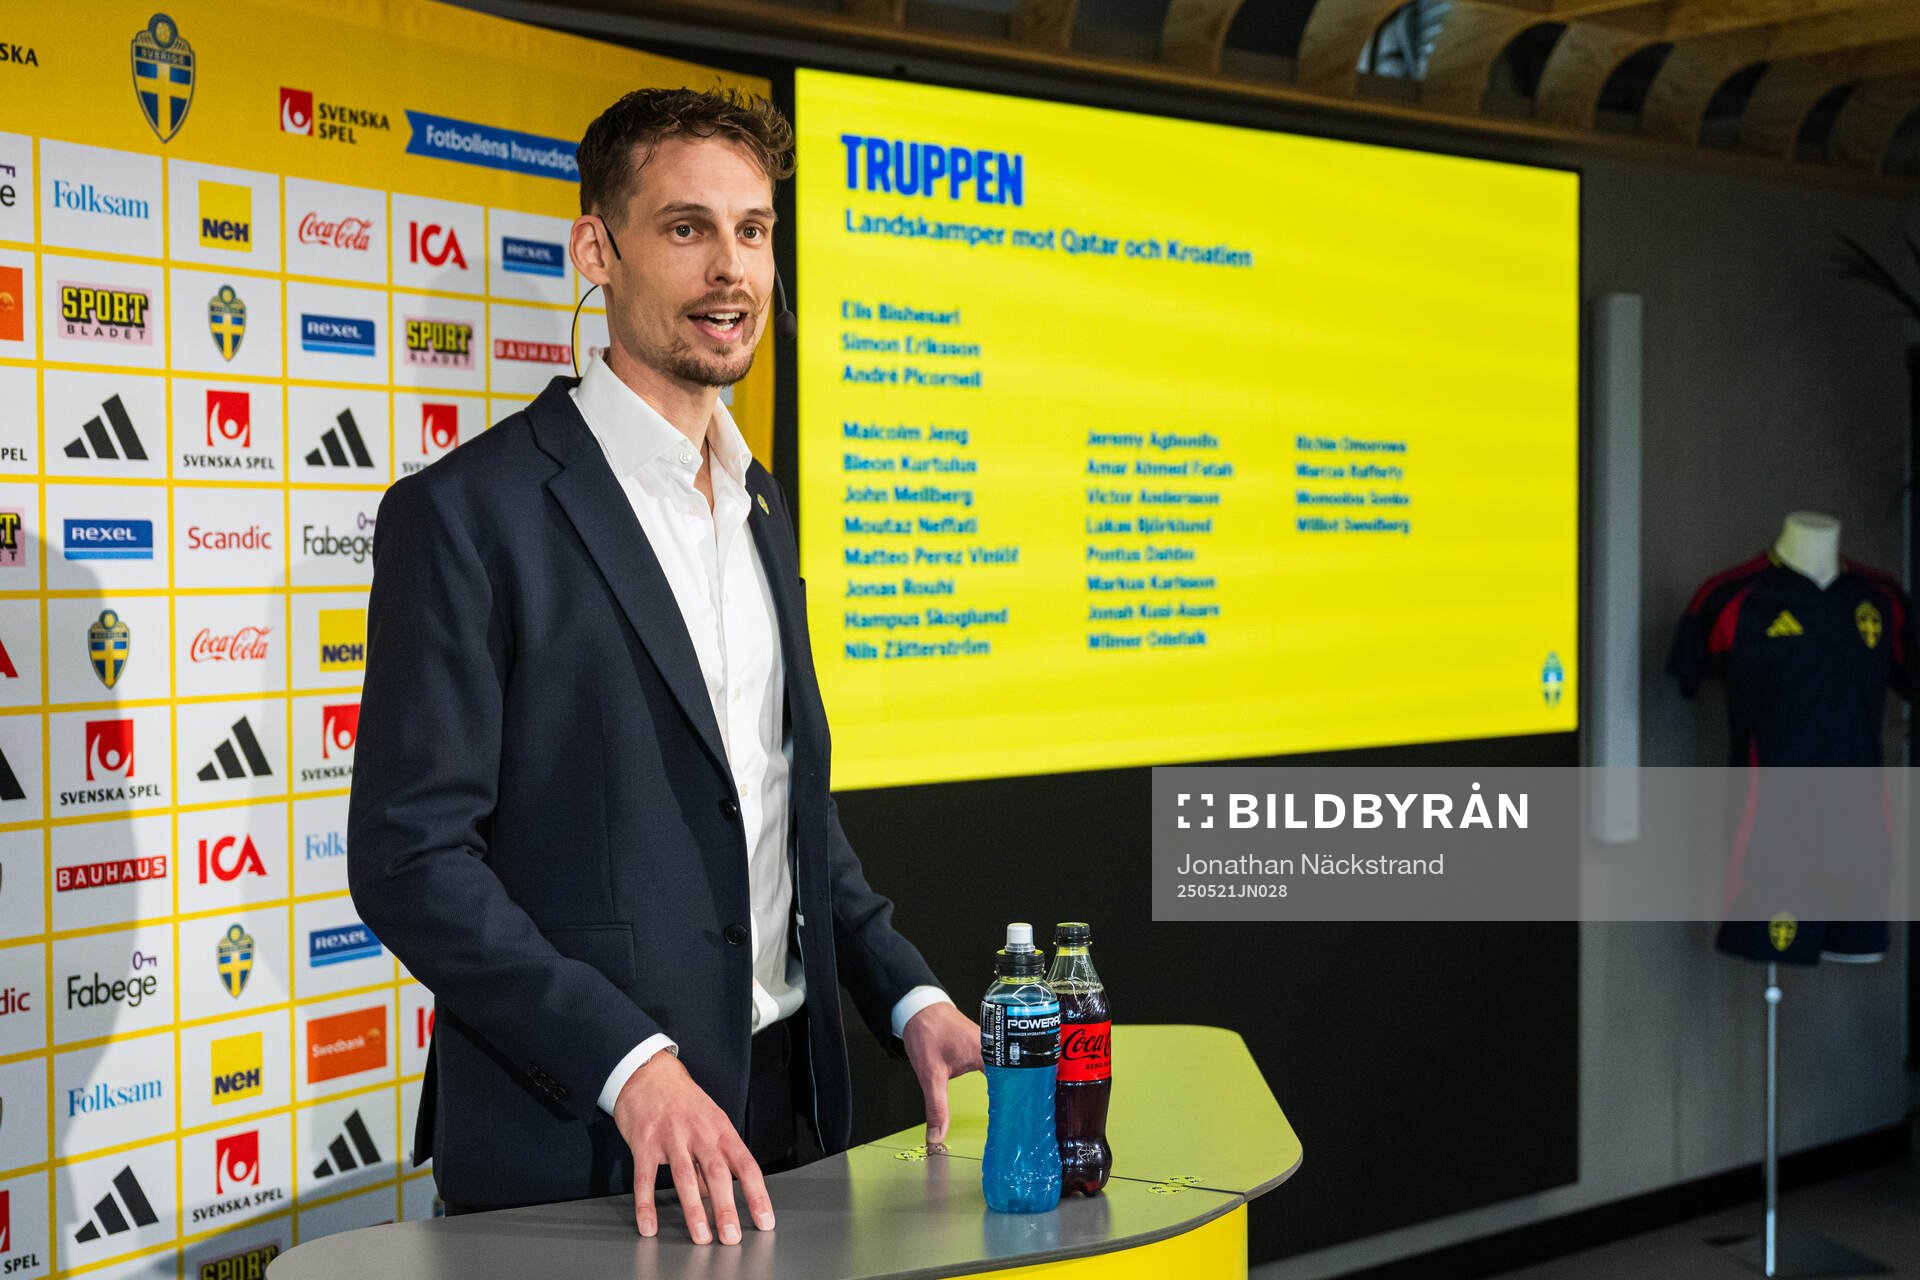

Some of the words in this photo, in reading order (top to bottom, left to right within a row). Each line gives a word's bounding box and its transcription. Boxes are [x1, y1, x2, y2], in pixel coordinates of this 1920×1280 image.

[318, 103, 390, 131] SVENSKA
[318, 122, 357, 144] SPEL
[426, 125, 508, 160] Fotbollens
[841, 134, 1023, 206] TRUPPEN
[53, 180, 149, 219] Folksam
[410, 222, 468, 270] ICA
[846, 208, 1005, 248] Landskamper
[1012, 230, 1055, 250] mot
[1061, 228, 1119, 255] Qatar
[1125, 239, 1162, 259] och
[1167, 241, 1252, 267] Kroatien
[62, 286, 149, 328] SPORT
[67, 324, 145, 340] BLADET
[406, 320, 472, 355] SPORT
[842, 333, 900, 352] Simon
[495, 340, 571, 363] BAUHAUS
[0, 447, 28, 461] PEL
[183, 454, 242, 468] SVENSKA
[246, 457, 275, 470] SPEL
[845, 486, 888, 503] John
[188, 526, 272, 550] Scandic
[60, 787, 125, 806] SVENSKA
[129, 784, 161, 798] SPEL
[198, 834, 267, 884] ICA
[305, 832, 346, 860] Folk
[57, 856, 166, 891] BAUHAUS
[67, 974, 157, 1009] Fabege
[1008, 1015, 1060, 1029] POWERA
[312, 1036, 365, 1057] Swedbank
[67, 1079, 163, 1117] Folksam
[192, 1199, 251, 1223] SVENSKA
[254, 1188, 283, 1205] SPEL
[4, 1253, 40, 1274] SPEL
